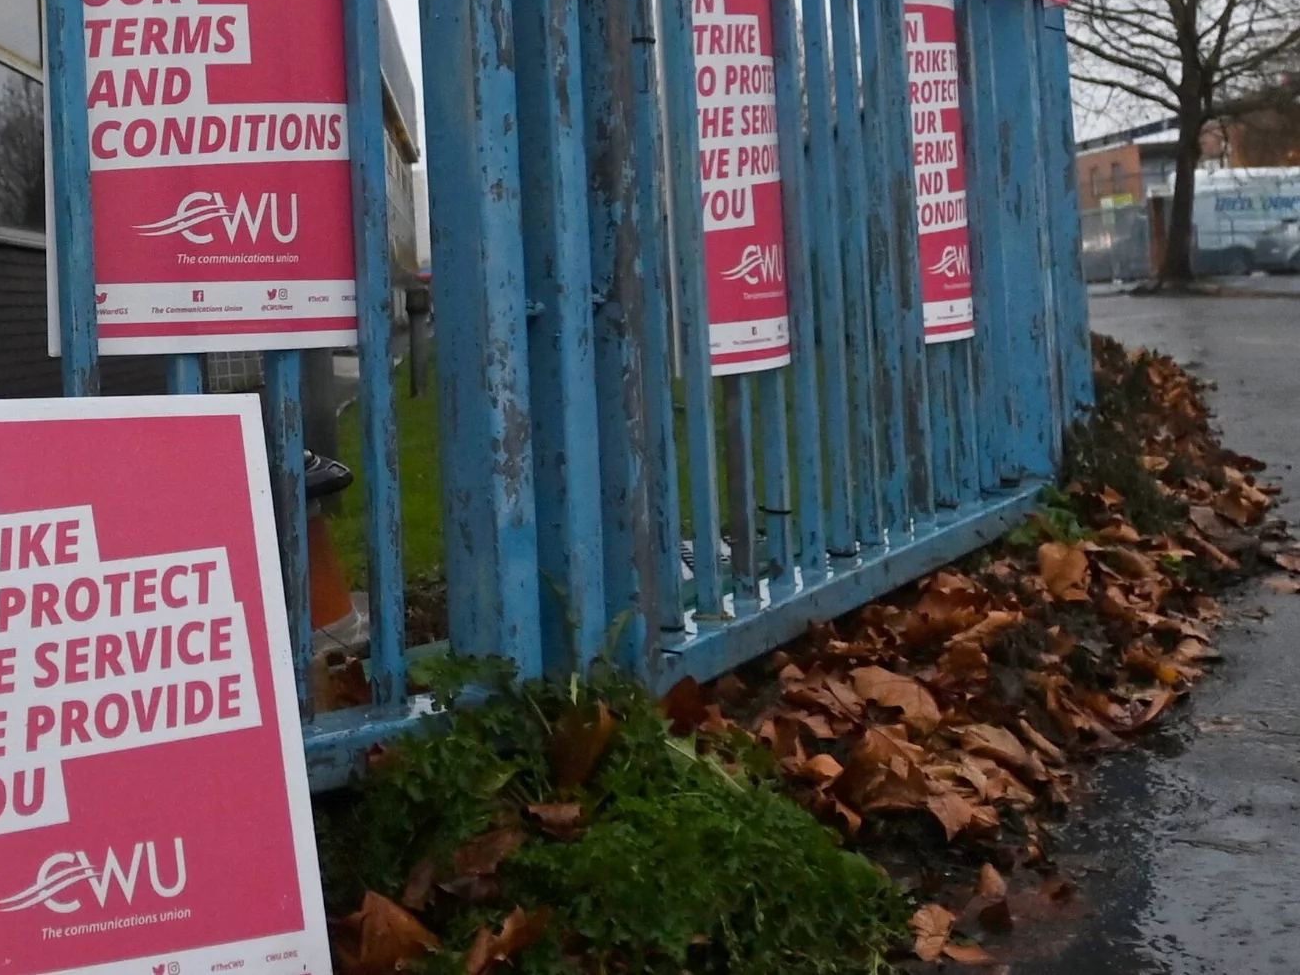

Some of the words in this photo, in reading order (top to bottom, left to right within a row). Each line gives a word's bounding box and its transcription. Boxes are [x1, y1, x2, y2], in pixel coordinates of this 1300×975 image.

[85, 15, 236, 58] TERMS
[693, 24, 756, 55] TRIKE
[905, 20, 918, 43] N
[907, 49, 946, 73] TRIKE
[87, 67, 192, 108] AND
[695, 65, 717, 97] O
[725, 64, 775, 95] PROTE
[909, 79, 958, 104] ROTECT
[91, 113, 342, 160] CONDITIONS
[697, 106, 734, 139] HE
[914, 111, 936, 135] UR
[913, 139, 954, 166] ERMS
[919, 171, 944, 196] ND
[176, 191, 298, 244] CWU
[177, 253, 195, 264] The
[197, 253, 274, 264] communications
[276, 253, 299, 263] union
[33, 617, 233, 689] SERVICE
[25, 674, 241, 753] PROVIDE
[36, 837, 187, 914] CWU
[41, 926, 62, 941] The
[64, 912, 158, 938] communications
[160, 907, 191, 921] union
